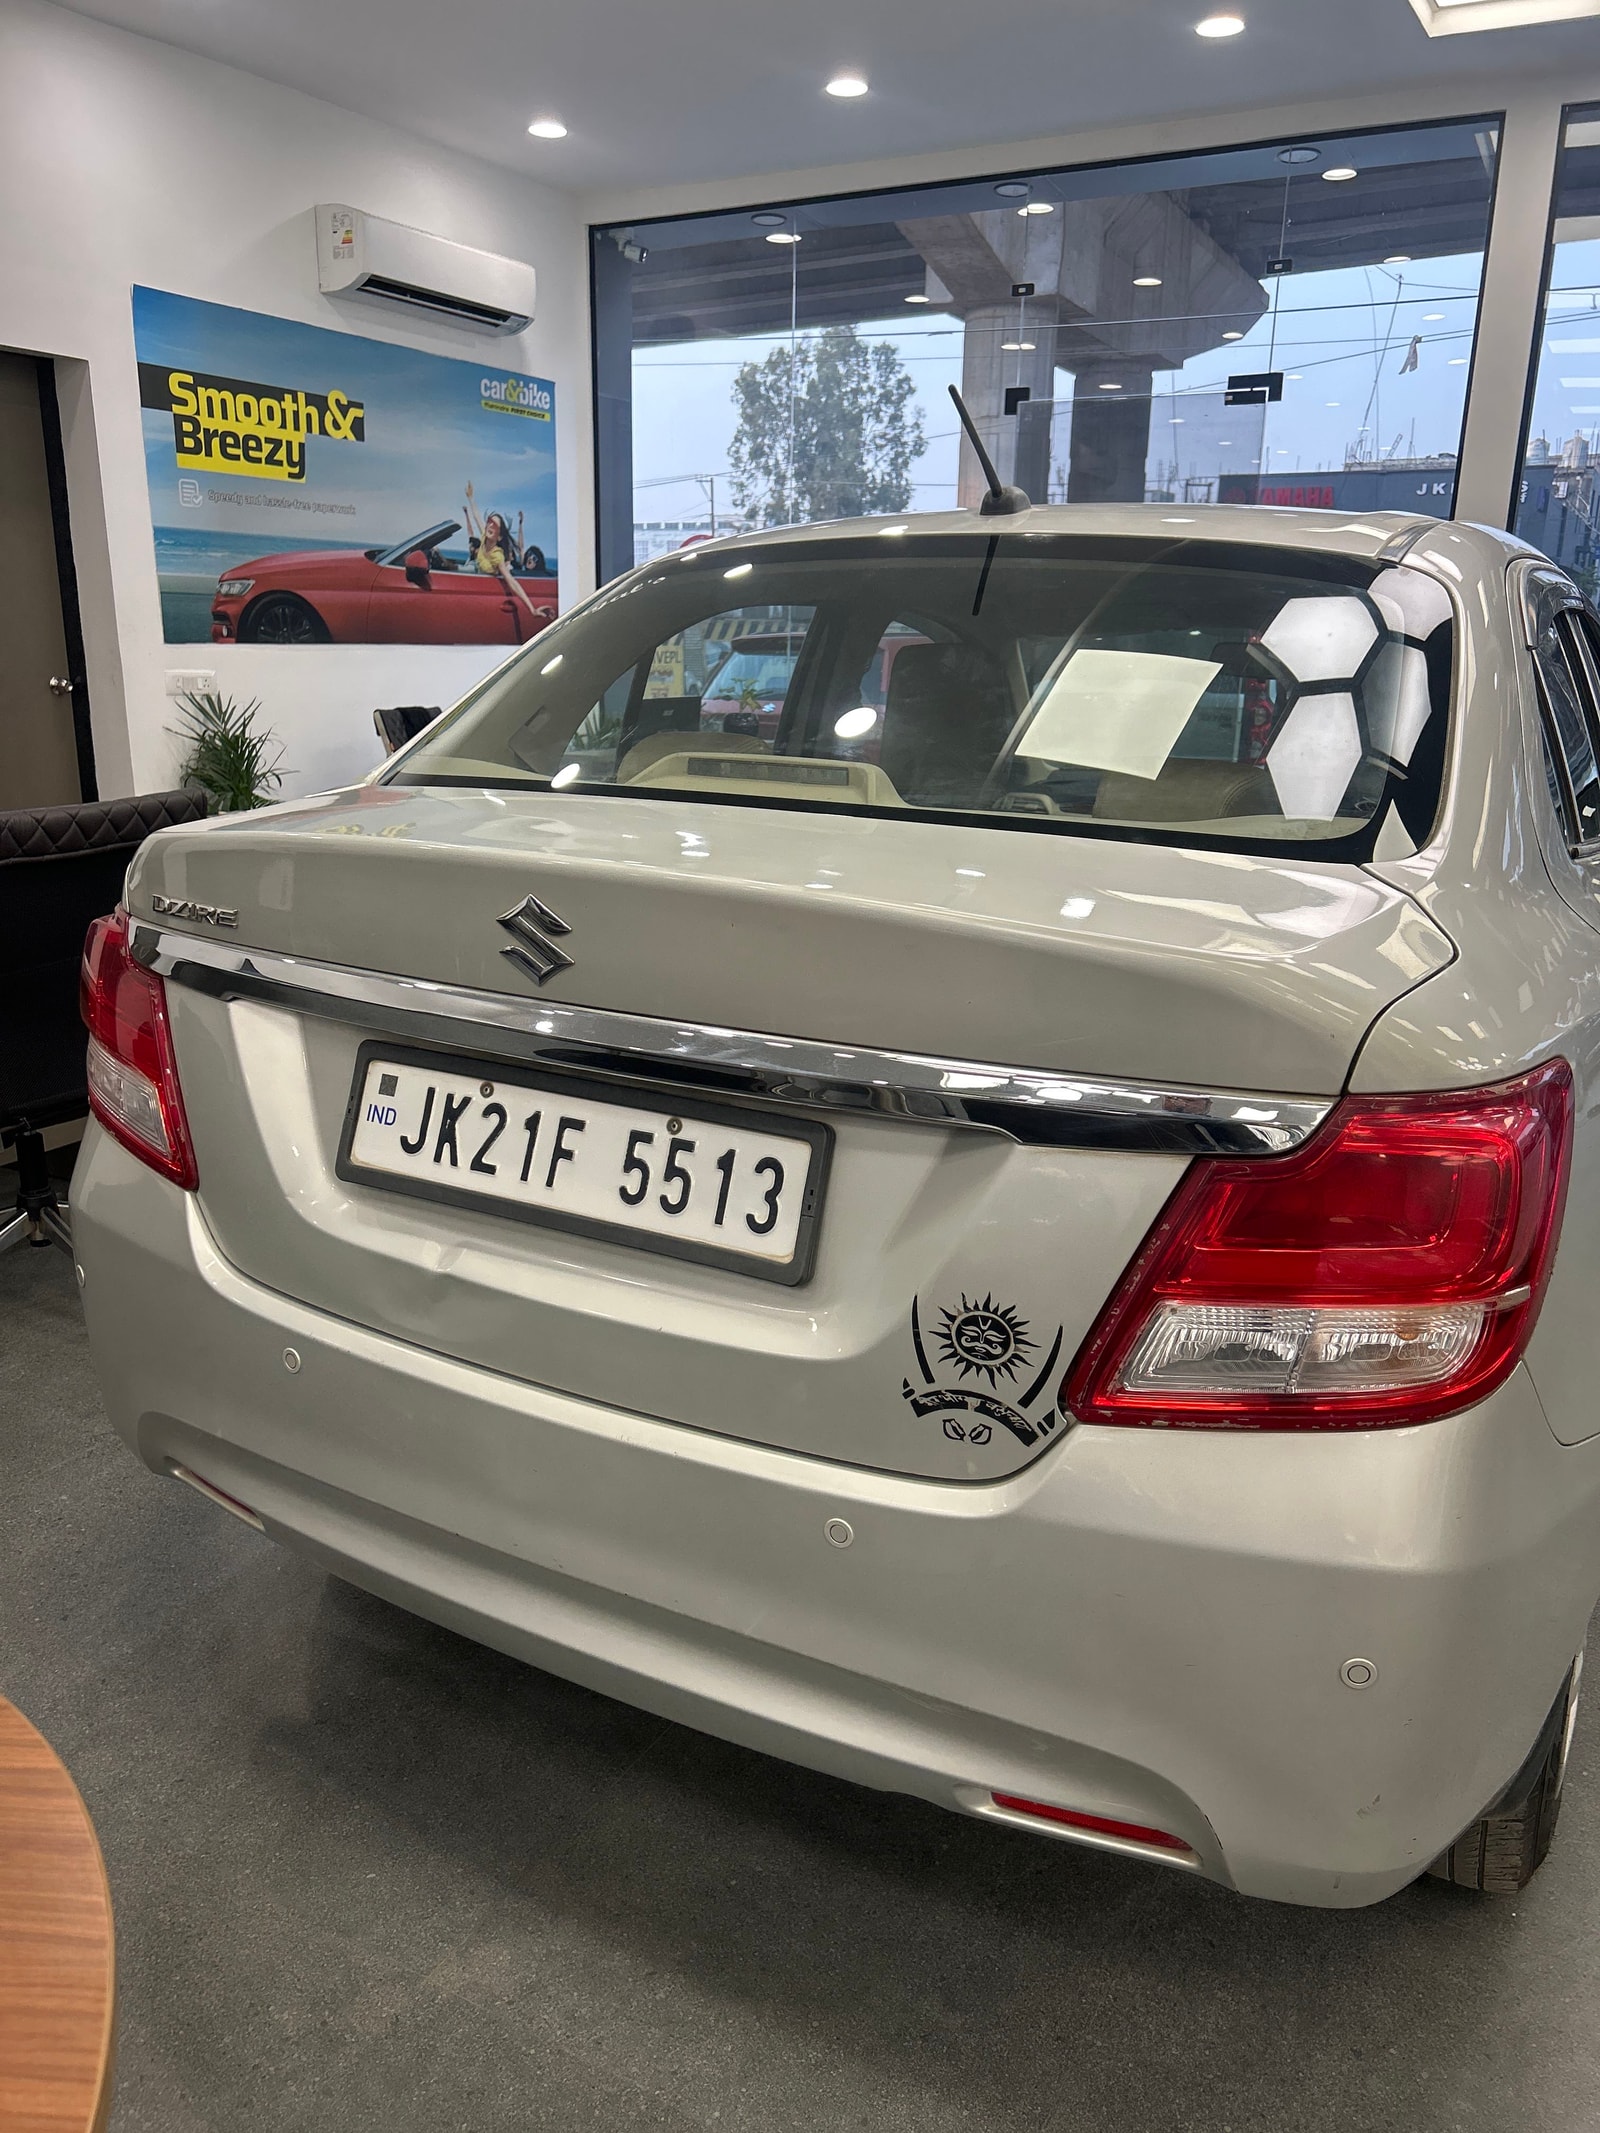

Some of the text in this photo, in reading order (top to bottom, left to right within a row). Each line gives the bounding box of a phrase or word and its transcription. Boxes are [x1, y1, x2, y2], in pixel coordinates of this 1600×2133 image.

[168, 372, 364, 441] Smooth &
[481, 379, 550, 410] car&bike
[173, 413, 306, 480] Breezy
[208, 489, 243, 507] Speedy
[244, 494, 262, 506] and
[152, 893, 238, 929] DZIRE
[366, 1103, 397, 1126] IND
[400, 1086, 785, 1235] JK21F 5513
